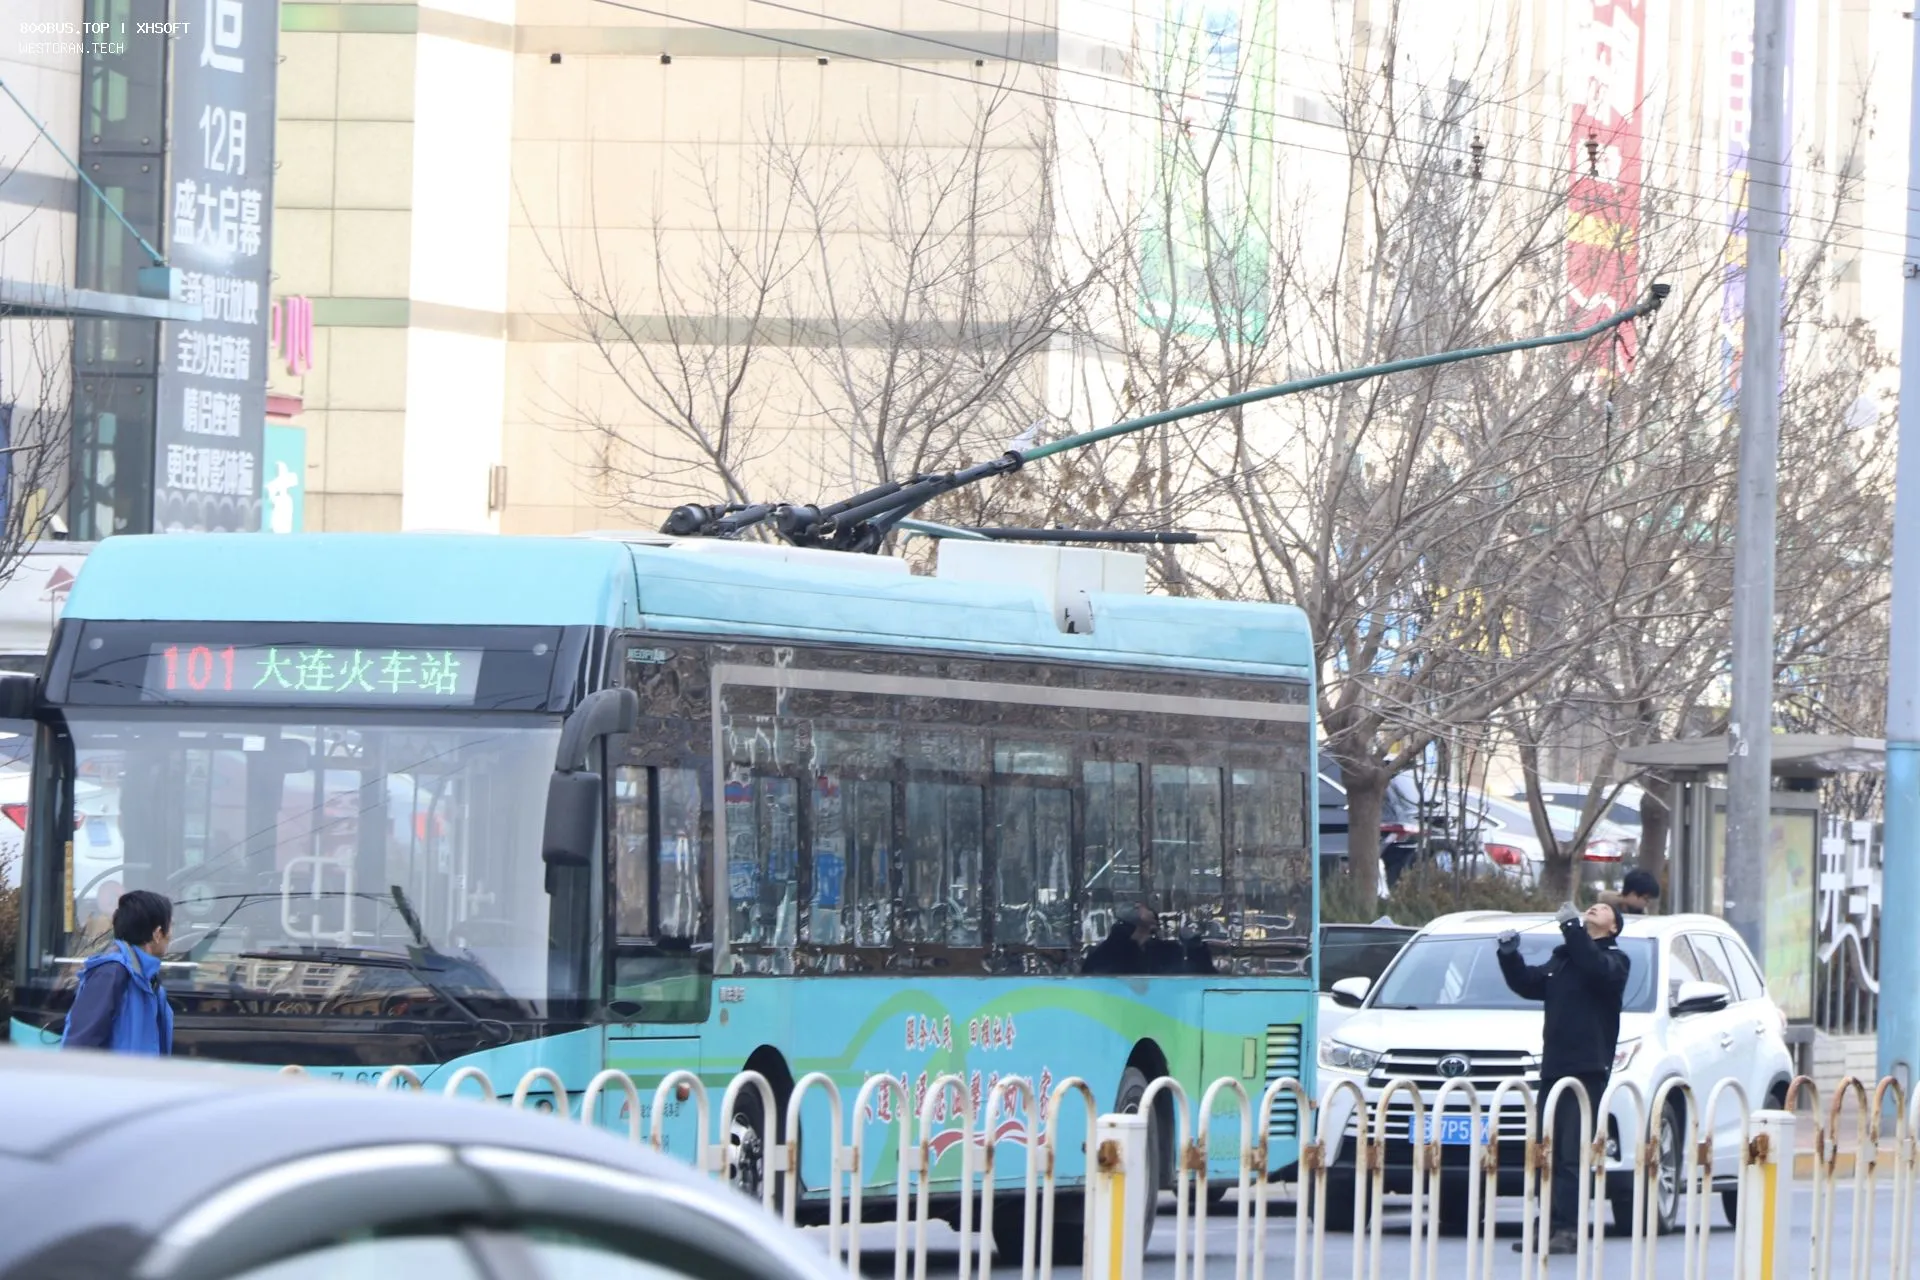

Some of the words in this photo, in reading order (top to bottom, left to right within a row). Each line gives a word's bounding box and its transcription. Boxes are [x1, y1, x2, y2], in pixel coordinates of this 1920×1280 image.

[199, 104, 247, 175] 12月
[173, 178, 262, 256] 盛大启幕
[164, 645, 235, 691] 101
[253, 647, 460, 695] 大连火车站
